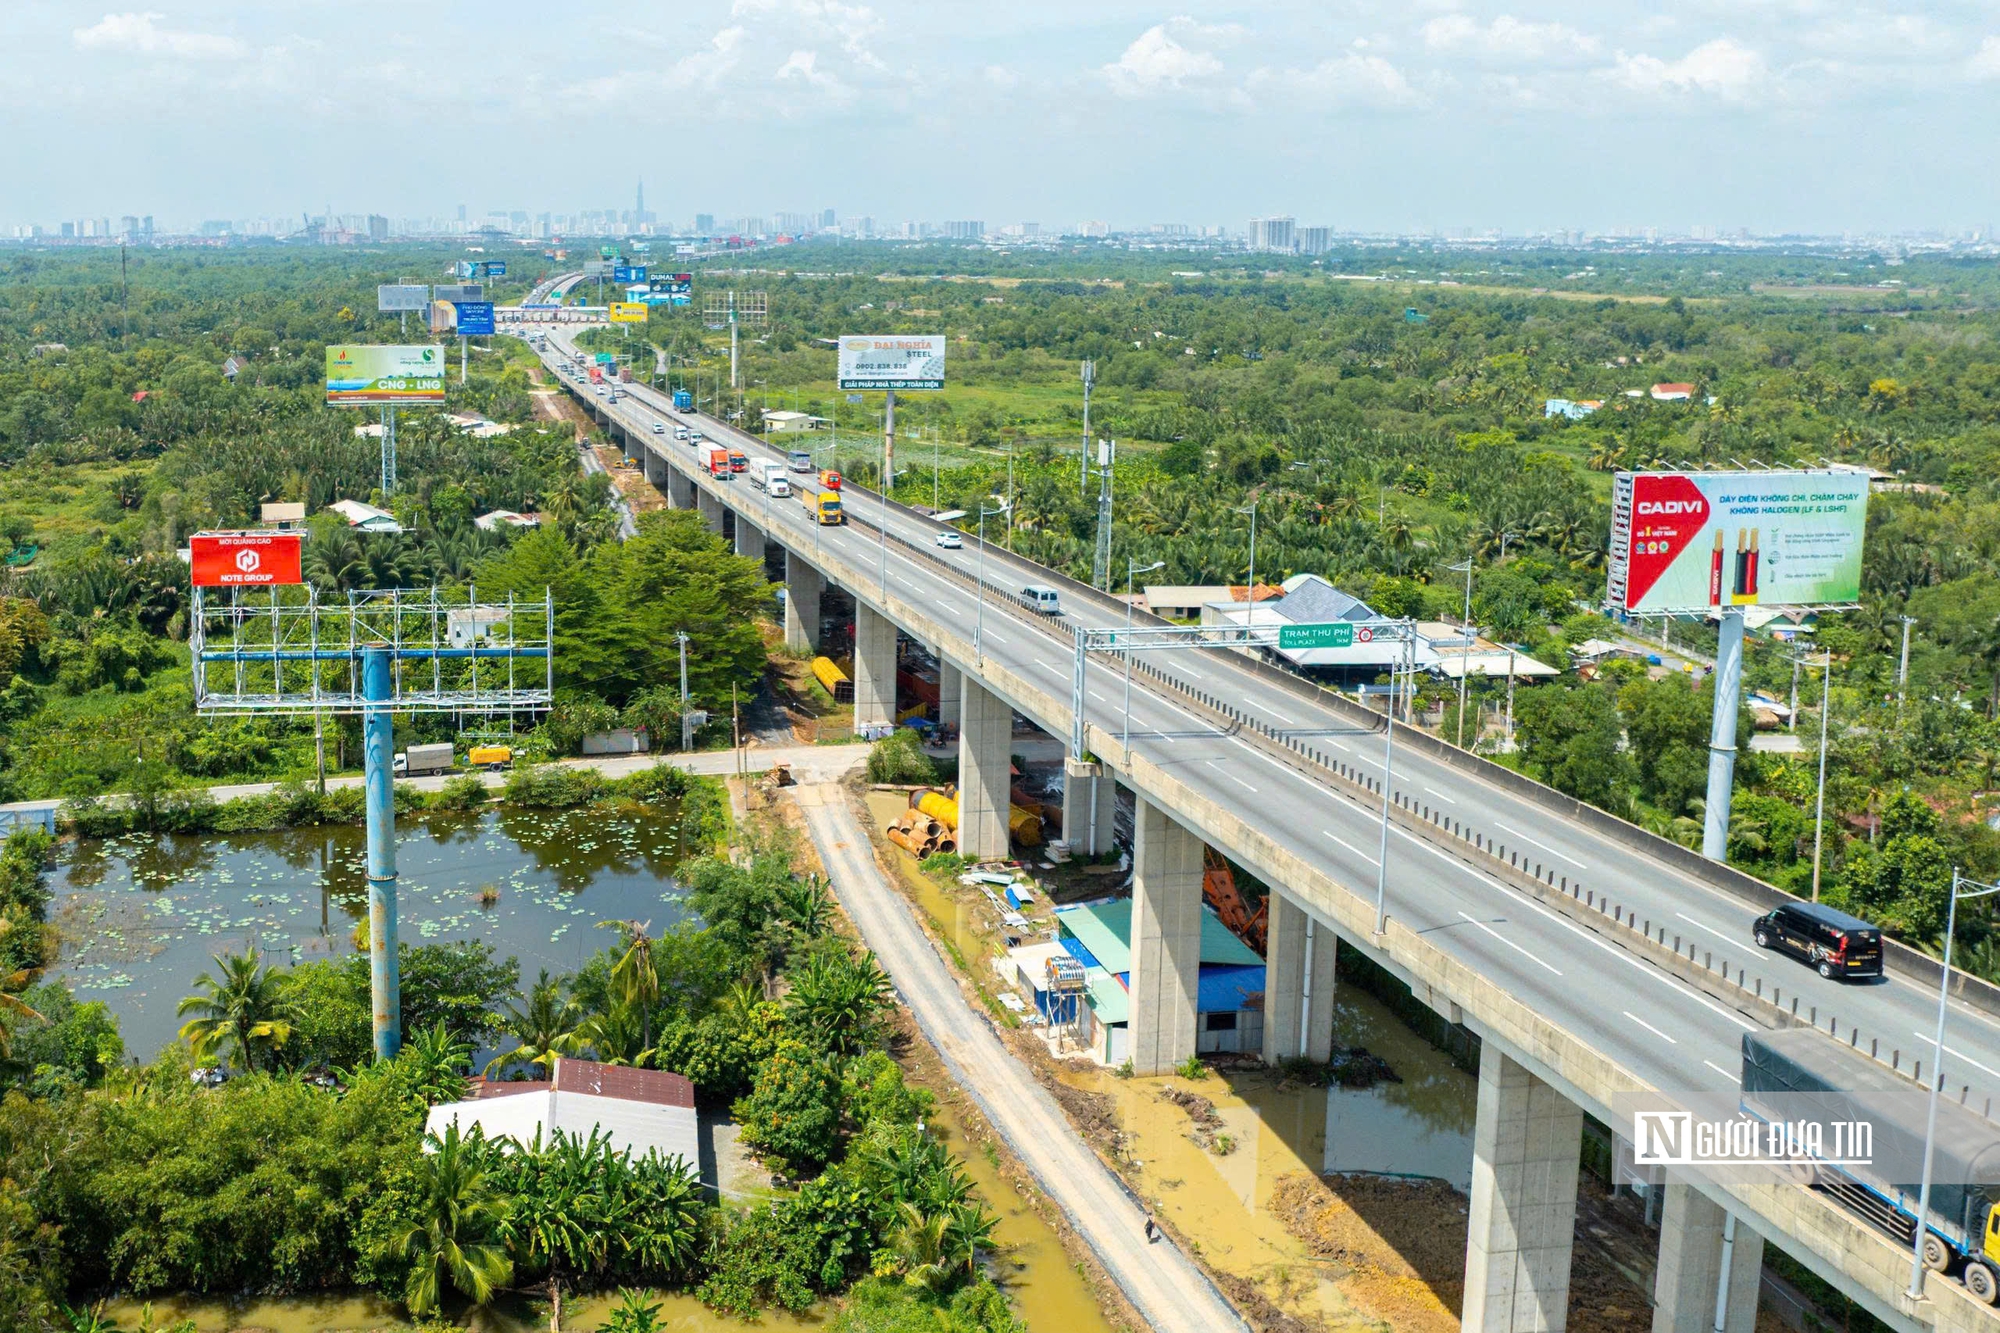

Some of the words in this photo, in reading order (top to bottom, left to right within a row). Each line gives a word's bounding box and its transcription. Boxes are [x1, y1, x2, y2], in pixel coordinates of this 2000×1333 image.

[378, 380, 407, 390] CNG
[417, 380, 441, 390] LNG
[1638, 501, 1702, 515] CADIVI
[1645, 526, 1651, 537] 1
[1284, 630, 1309, 638] TRẠM
[1334, 626, 1350, 636] PHÍ
